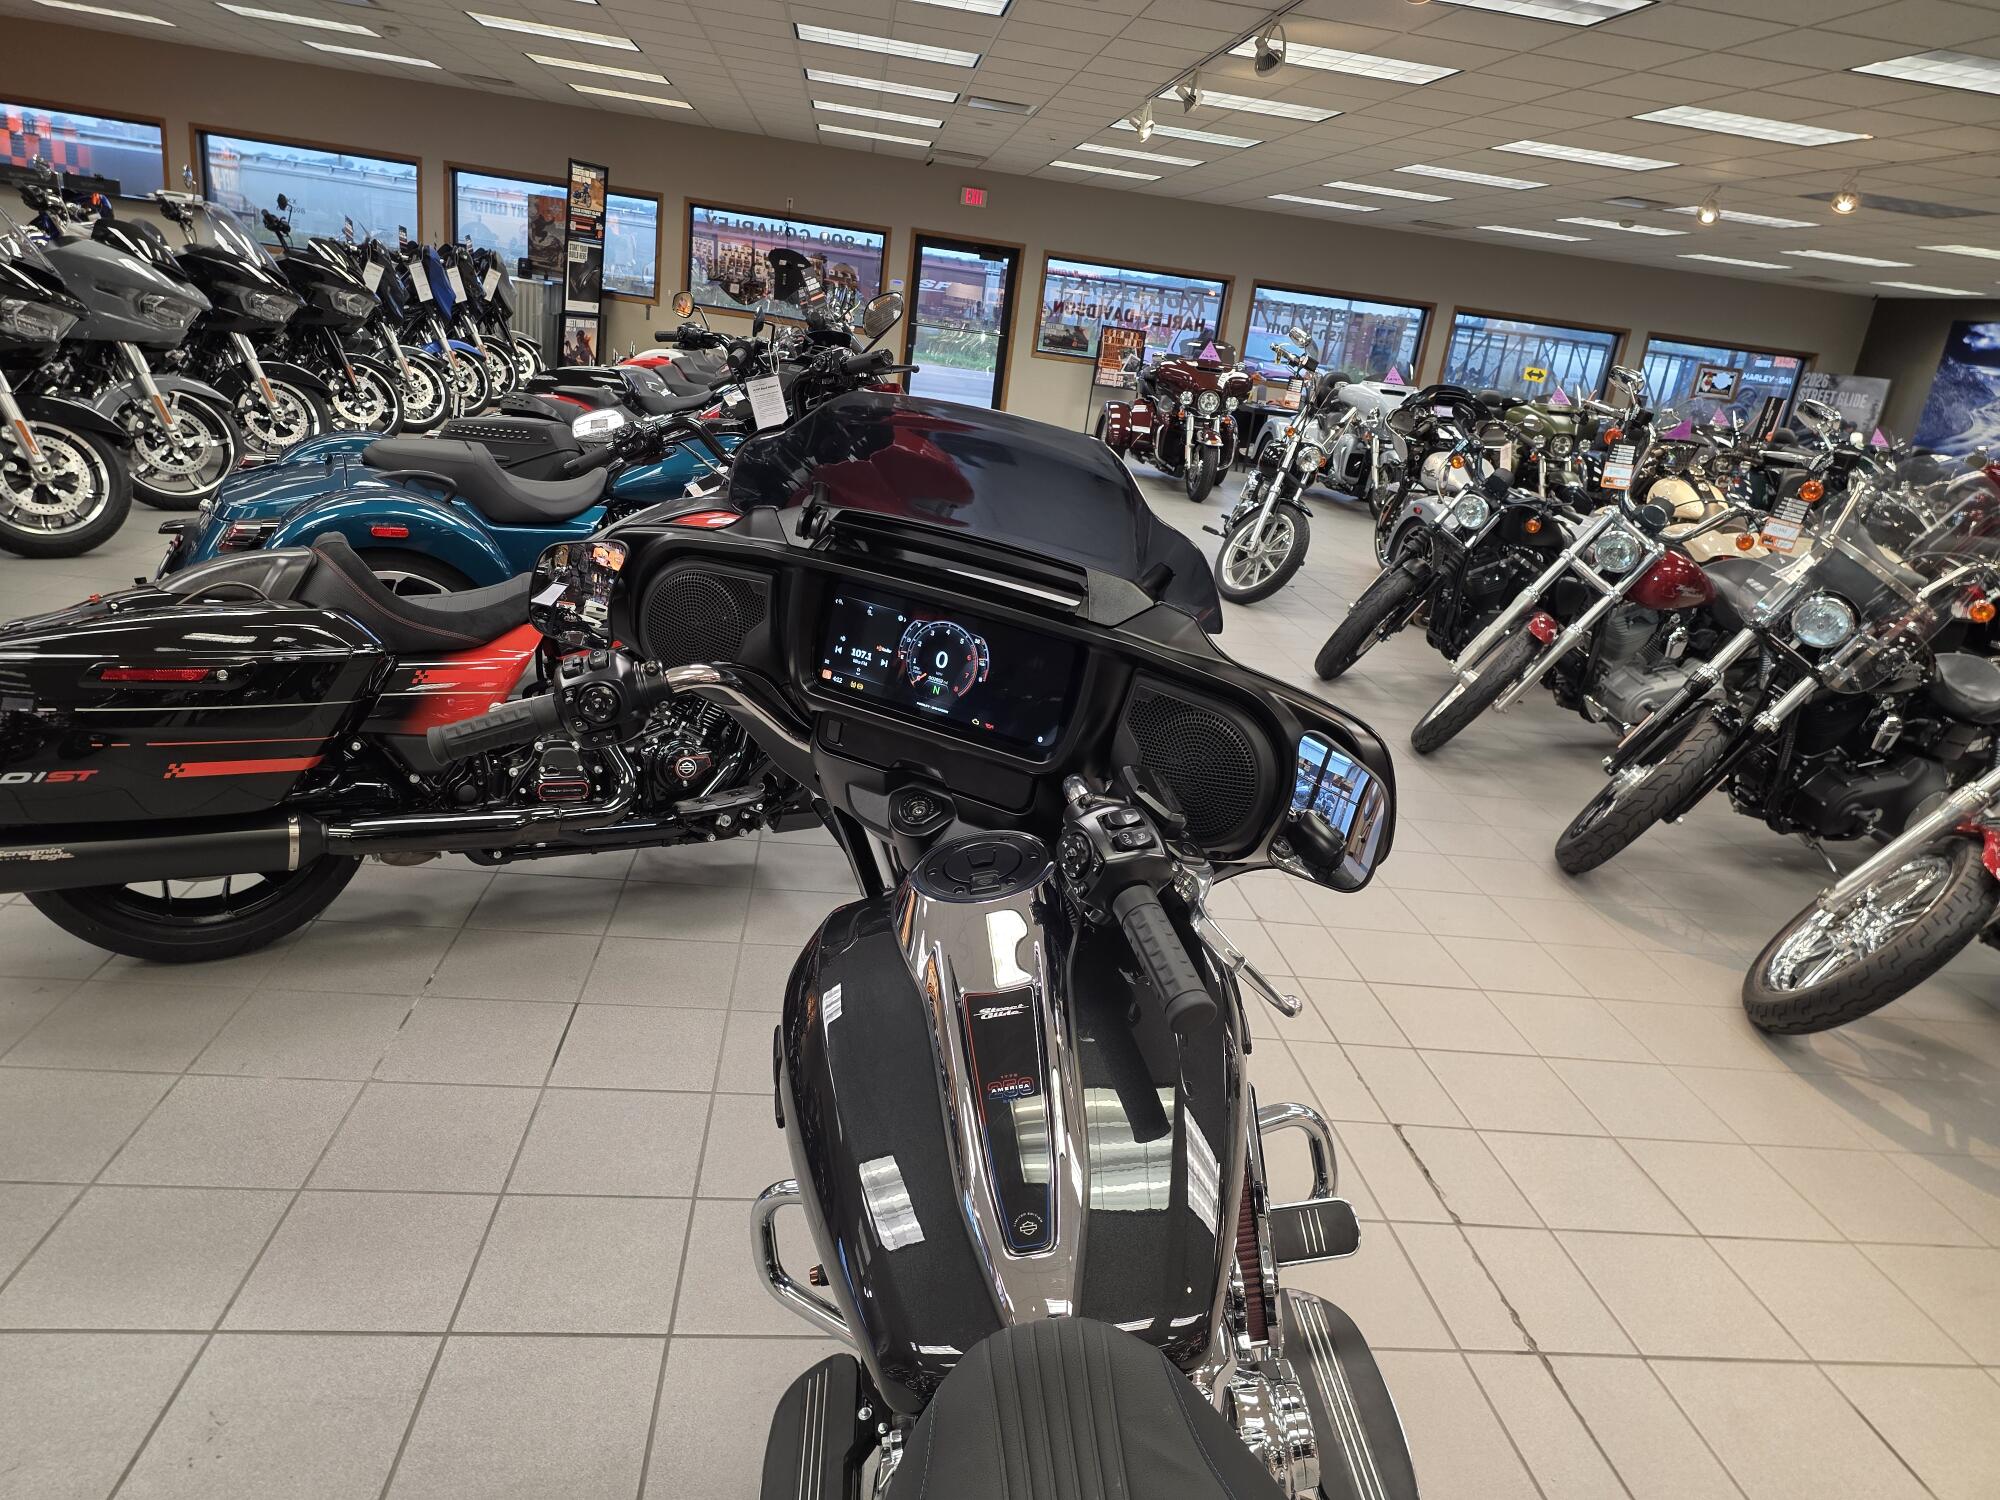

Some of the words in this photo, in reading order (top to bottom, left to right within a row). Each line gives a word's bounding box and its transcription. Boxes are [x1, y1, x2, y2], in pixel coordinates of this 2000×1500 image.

[965, 188, 984, 206] EXIT
[1802, 372, 1831, 390] 2026
[1799, 387, 1838, 406] STREET
[1837, 391, 1869, 409] GLIDE
[935, 651, 949, 669] 0
[932, 685, 940, 695] N
[979, 1004, 1030, 1014] Street
[991, 1083, 1030, 1094] AMERICA
